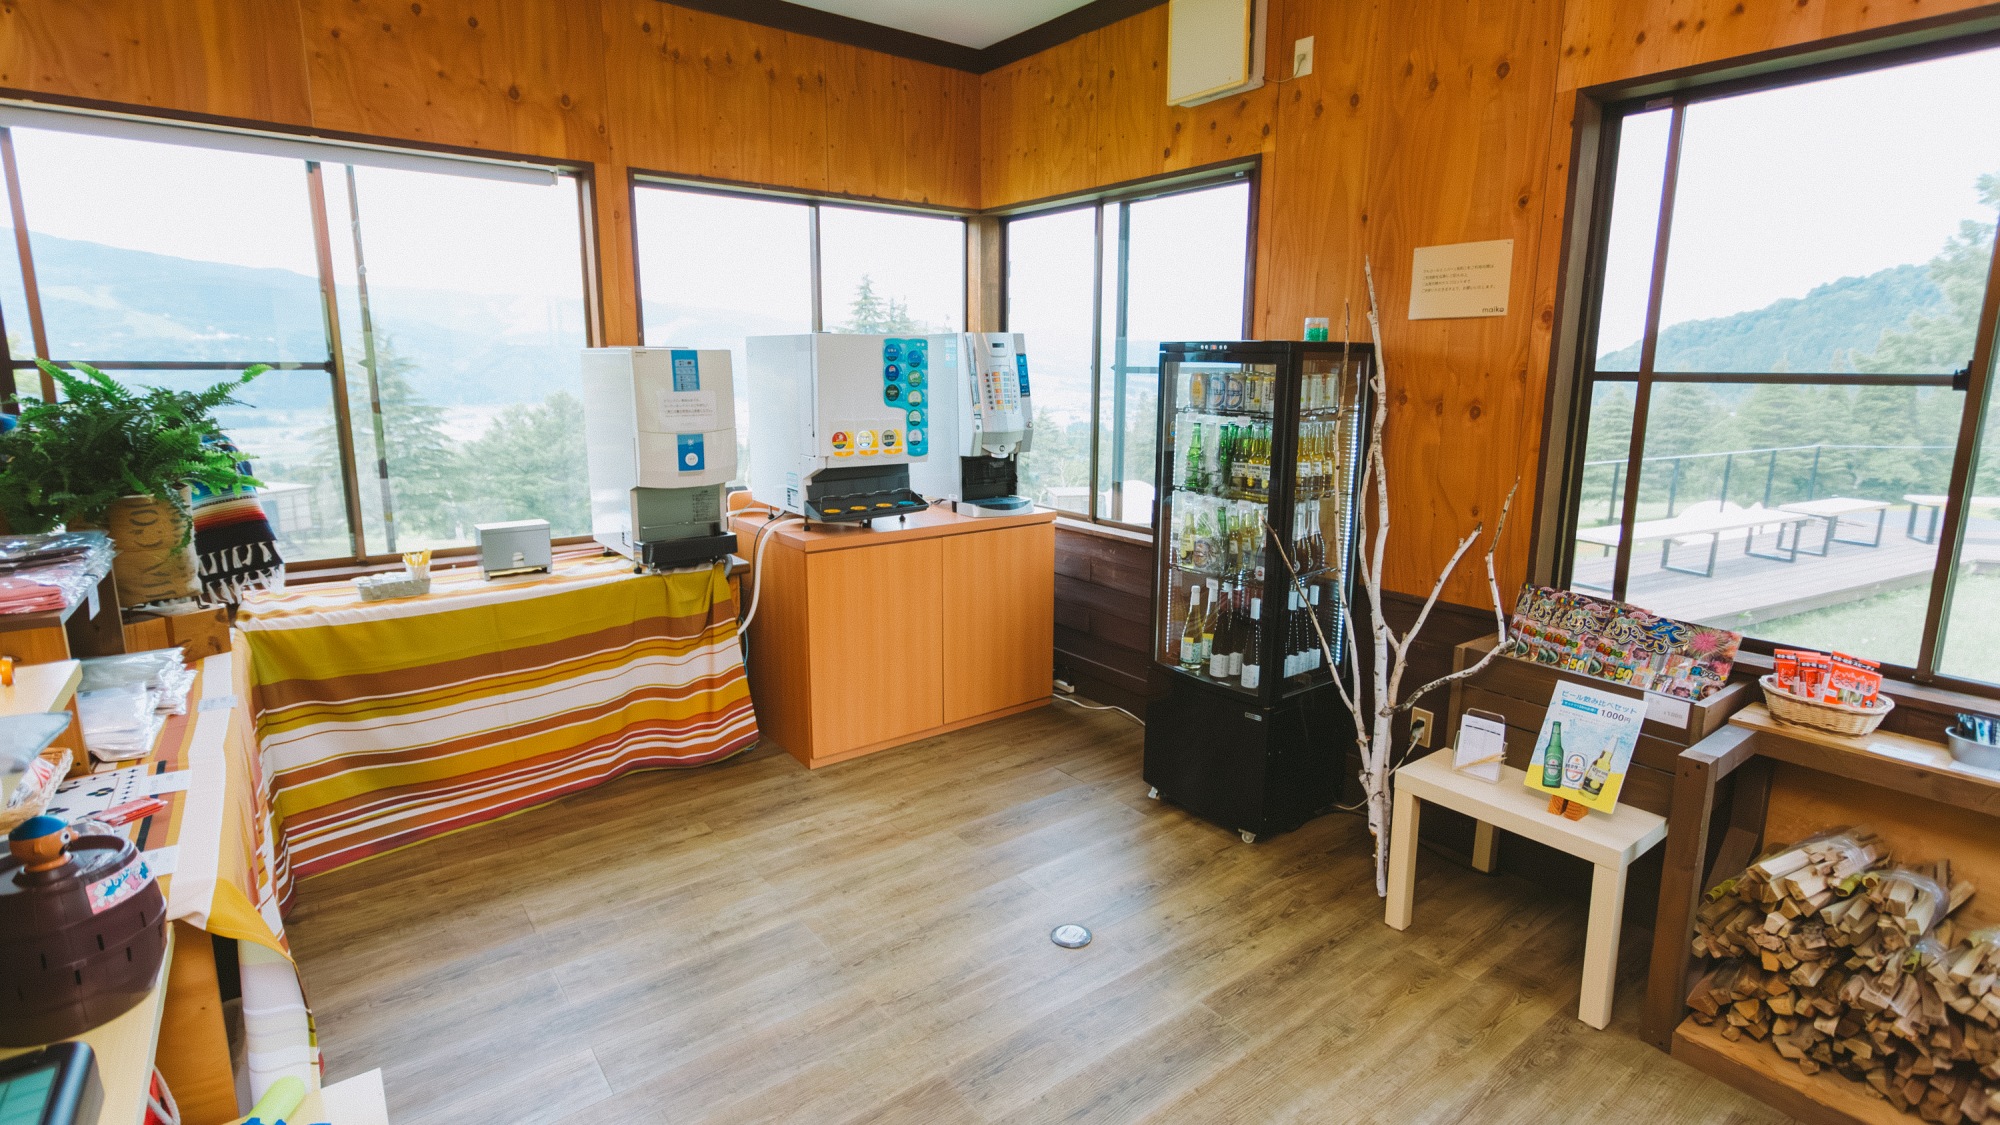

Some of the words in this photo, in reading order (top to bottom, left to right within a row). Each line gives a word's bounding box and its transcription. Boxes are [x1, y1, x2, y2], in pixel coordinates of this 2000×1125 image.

[1615, 667, 1633, 680] 50
[1561, 690, 1637, 715] ビール飲み比べセット
[1601, 709, 1631, 724] 1,000円
